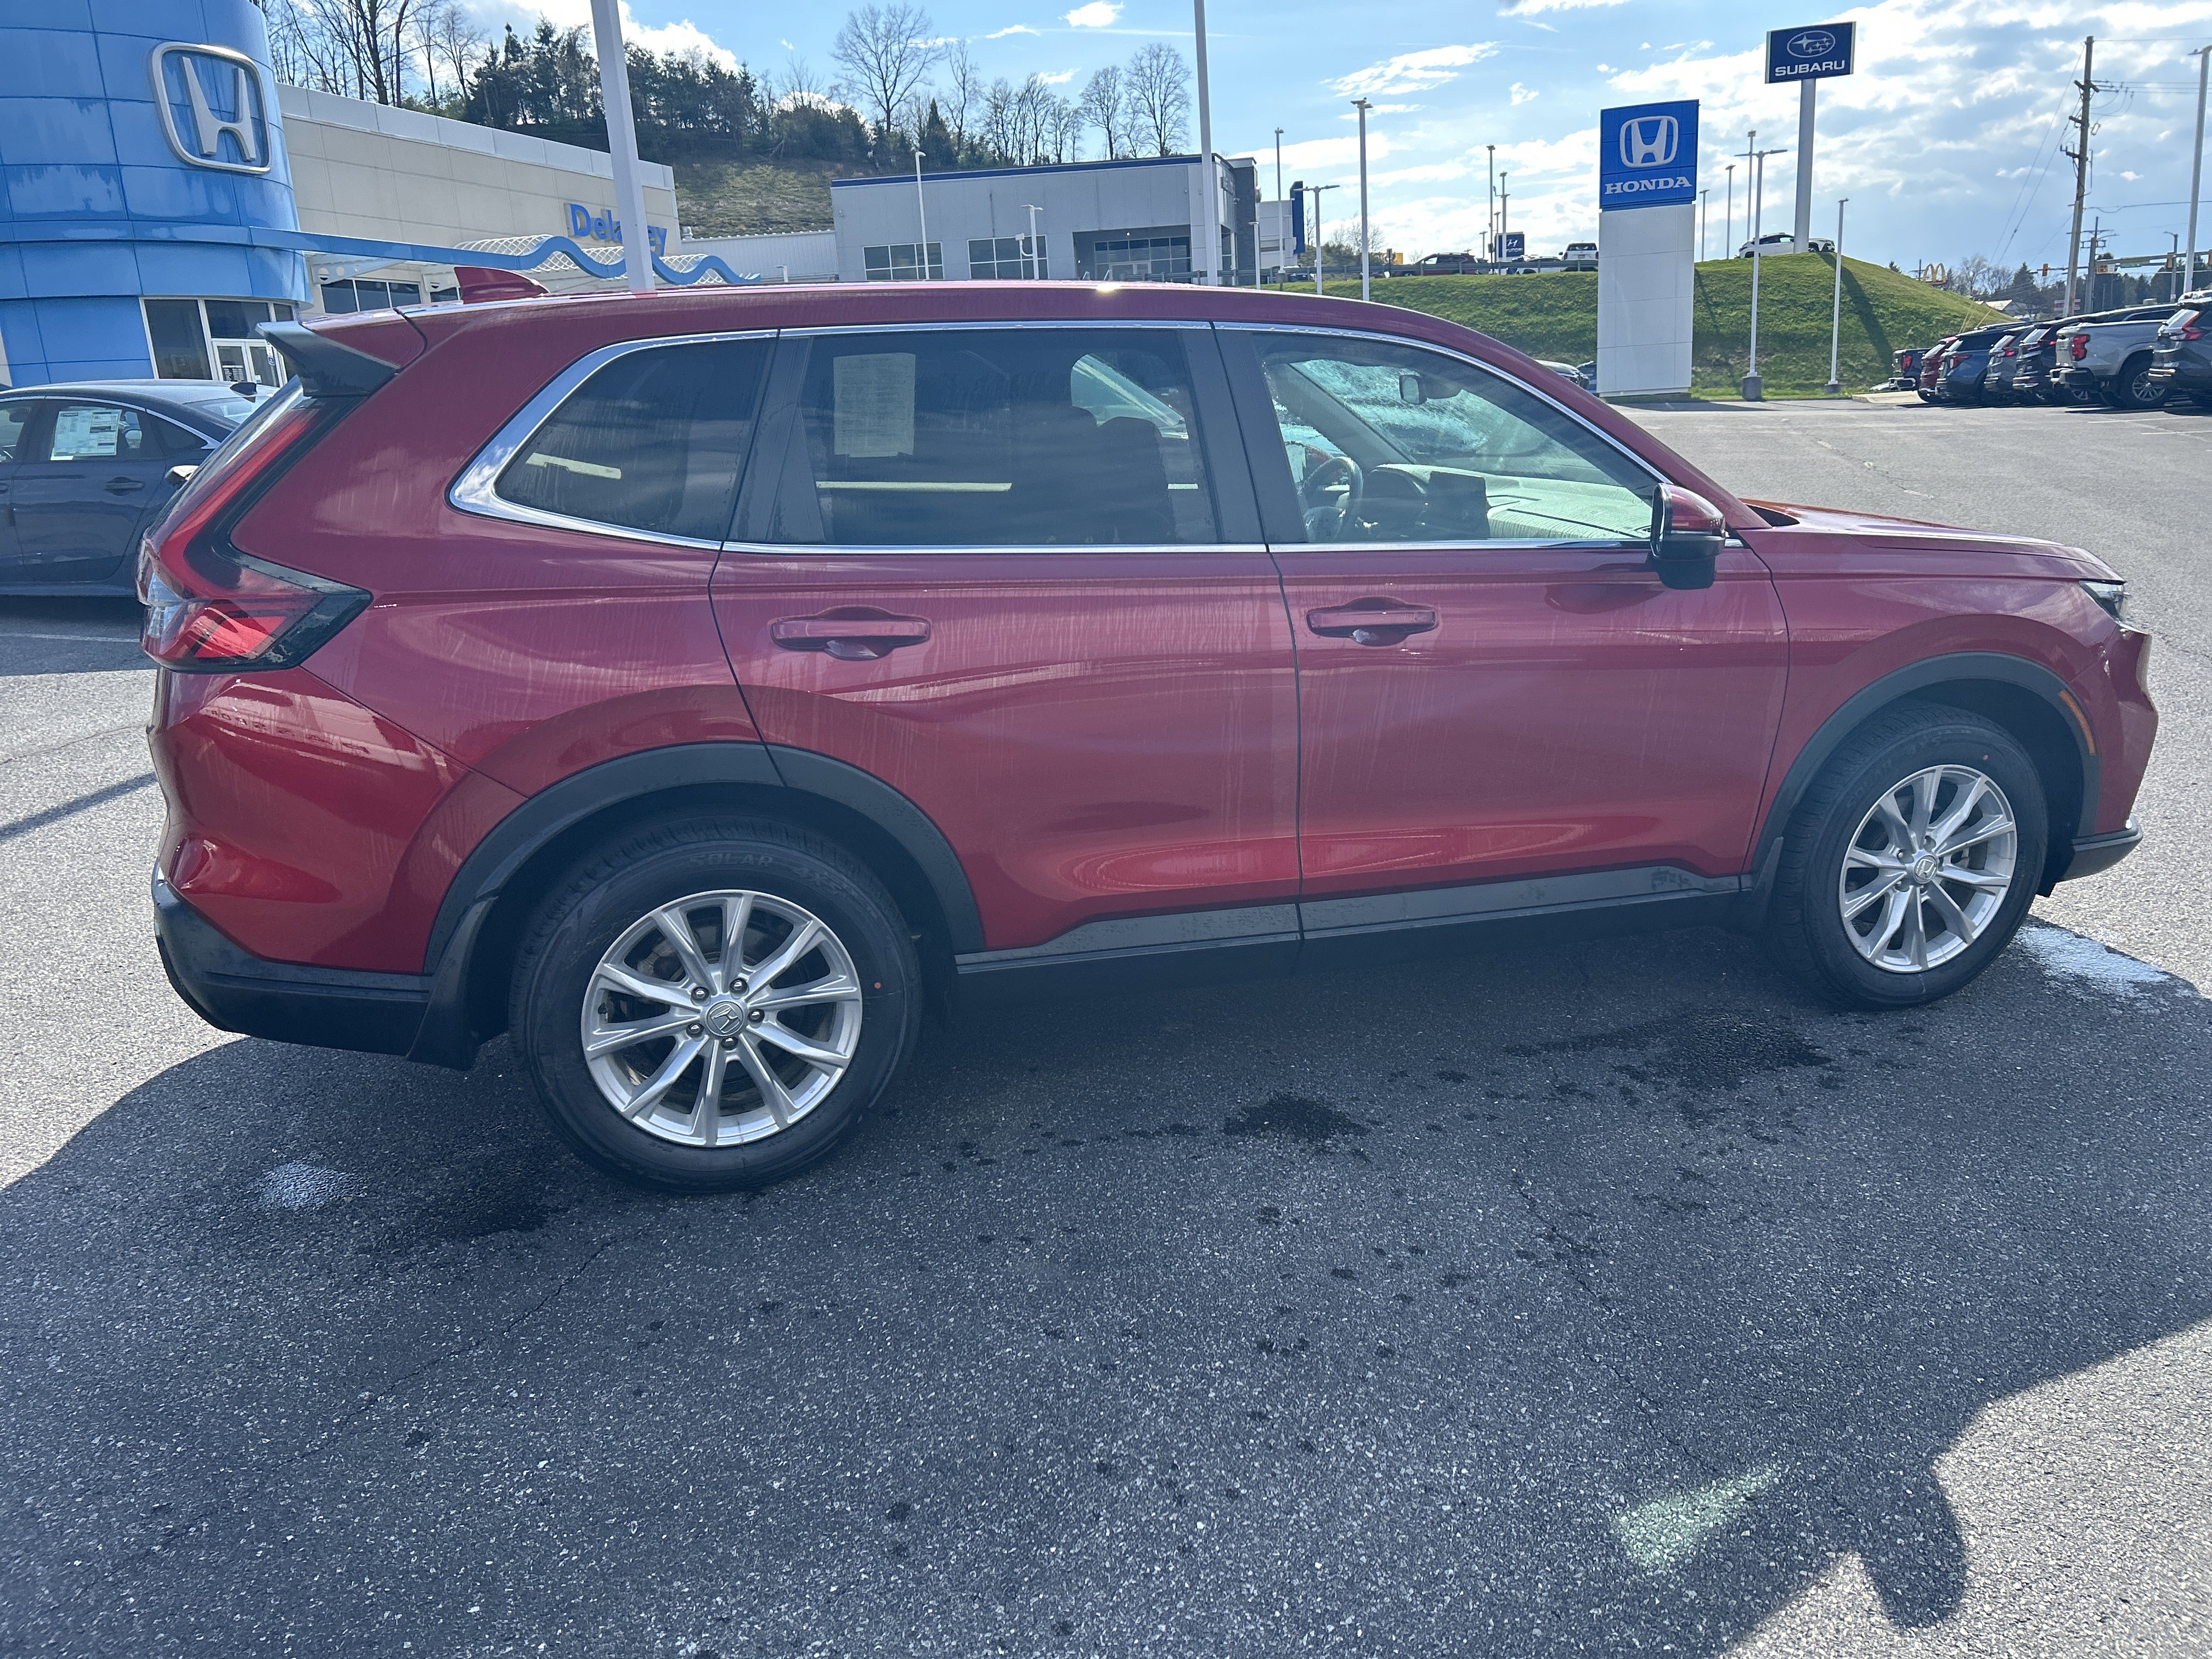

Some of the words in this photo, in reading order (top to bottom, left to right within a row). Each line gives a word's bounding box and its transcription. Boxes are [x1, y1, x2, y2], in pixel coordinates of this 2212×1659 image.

[1775, 60, 1845, 76] SUBARU
[1604, 176, 1692, 195] HONDA
[570, 204, 667, 256] Delaey
[689, 853, 773, 866] SOLAR
